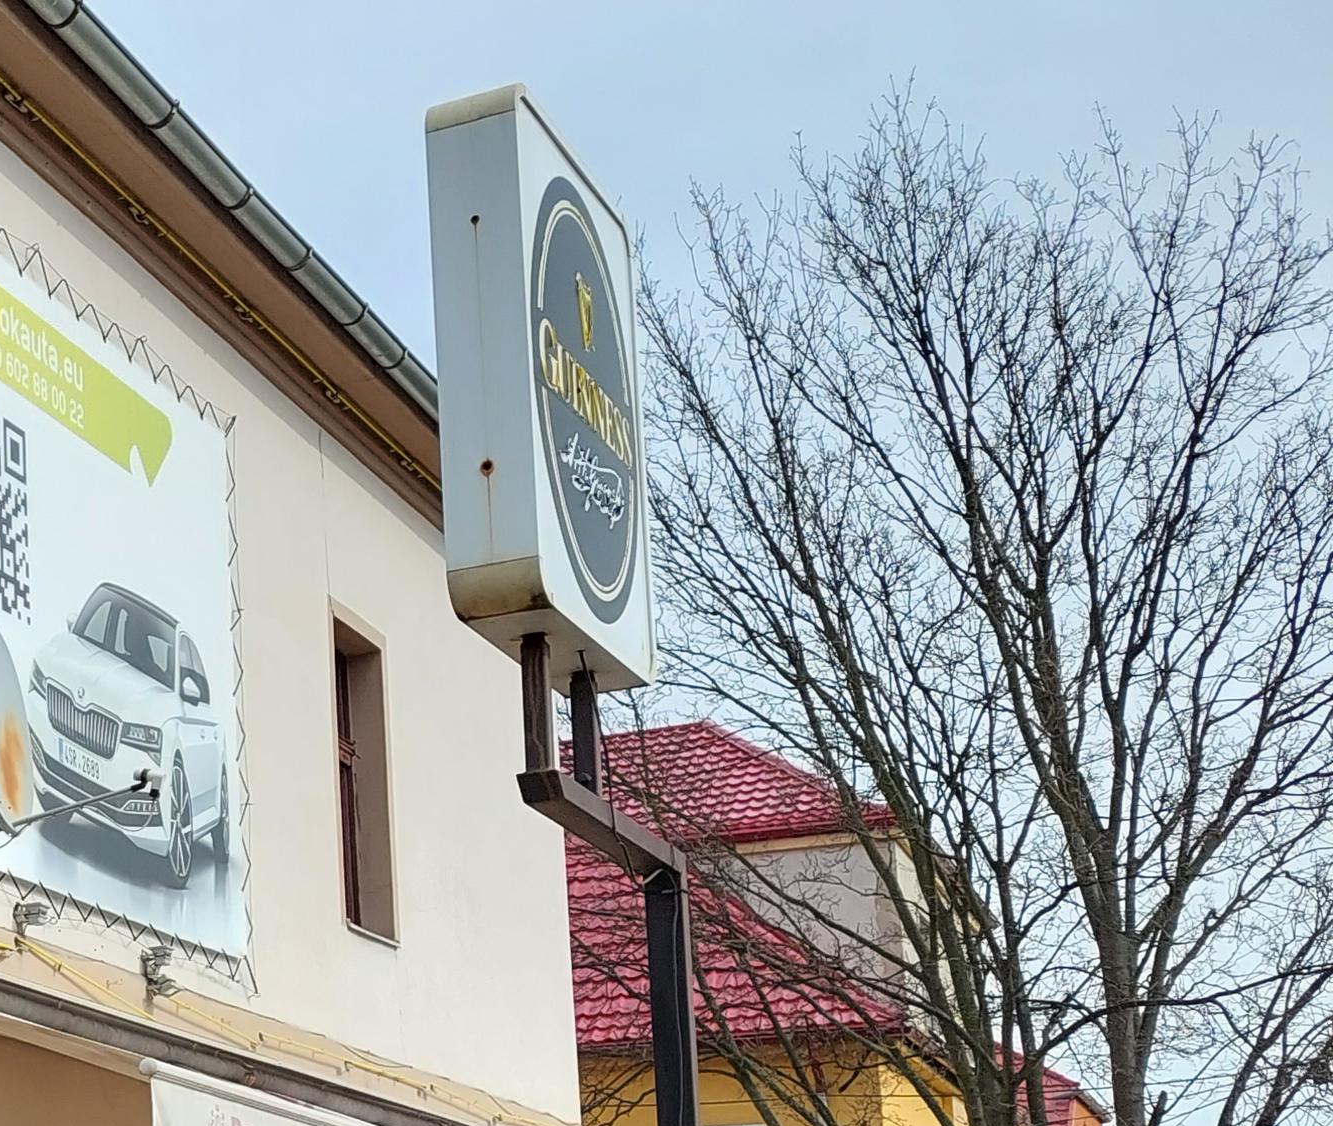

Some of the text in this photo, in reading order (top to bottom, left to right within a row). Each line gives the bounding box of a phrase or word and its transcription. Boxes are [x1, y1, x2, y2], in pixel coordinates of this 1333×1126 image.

[6, 352, 30, 389] 602
[33, 372, 48, 402] 88
[51, 386, 66, 416] 00
[69, 399, 84, 429] 22
[539, 318, 633, 470] GUINNESS
